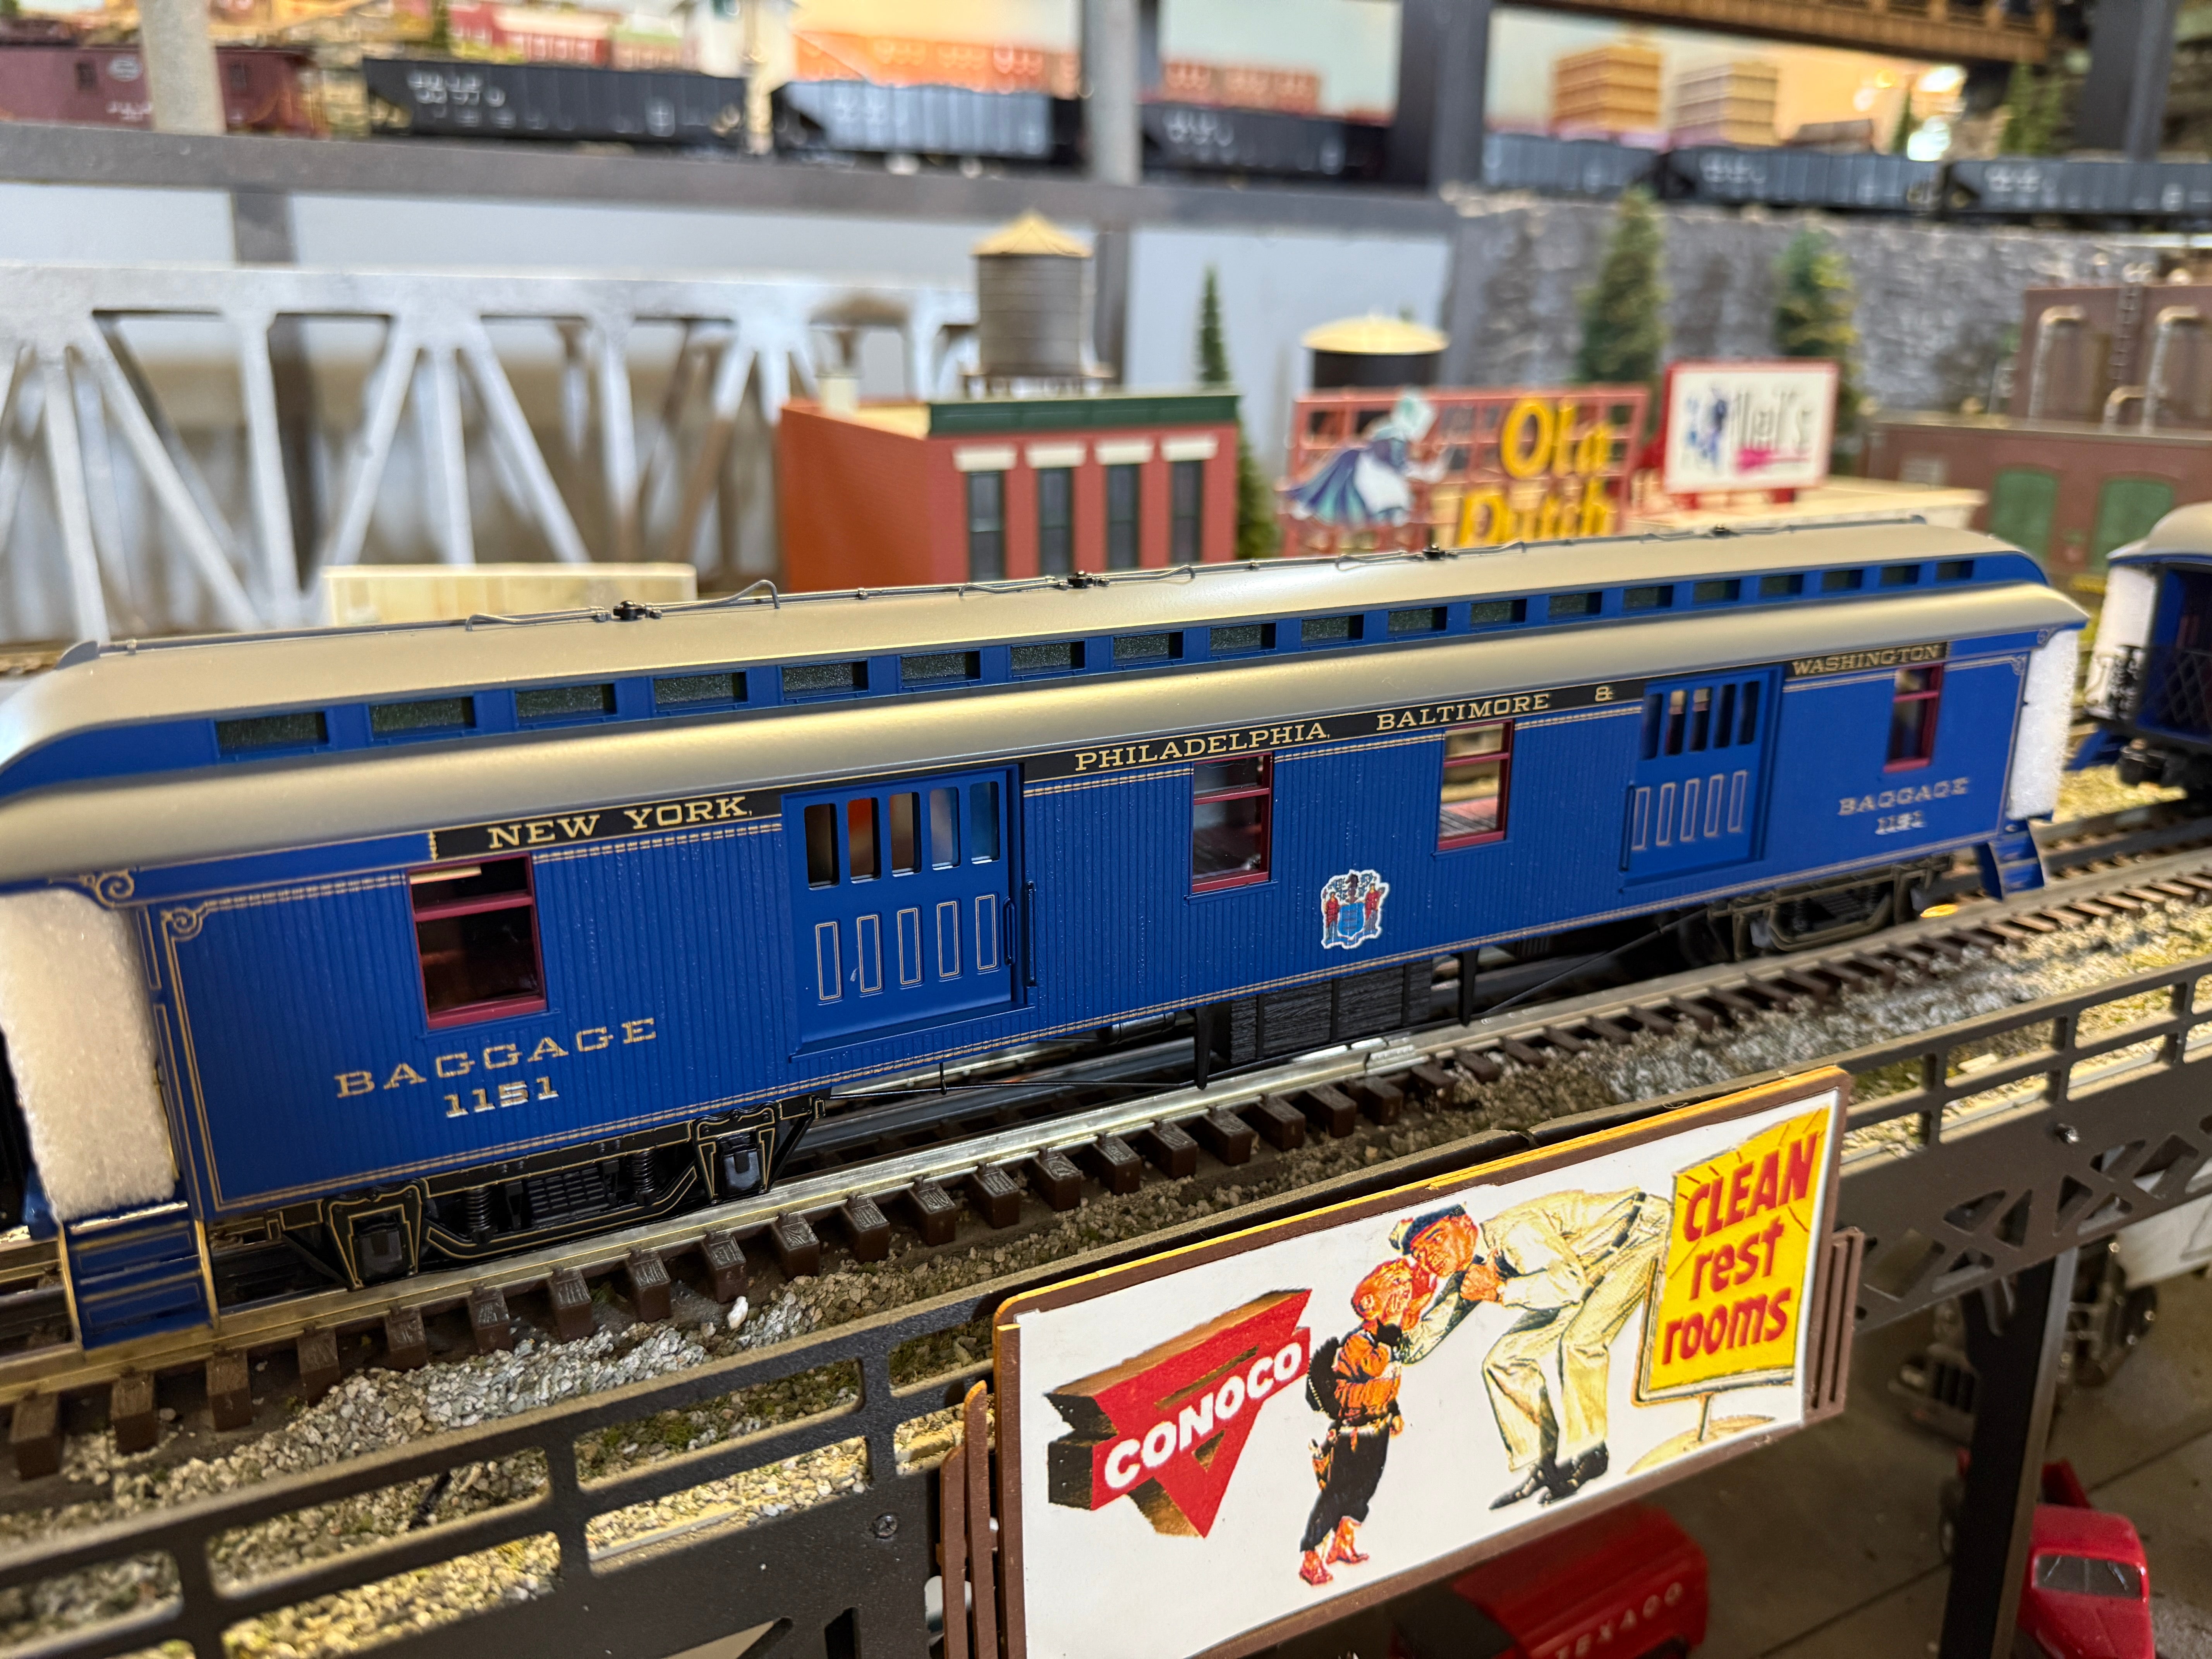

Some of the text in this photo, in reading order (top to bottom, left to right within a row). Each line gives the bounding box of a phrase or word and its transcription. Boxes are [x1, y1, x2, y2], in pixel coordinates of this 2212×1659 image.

[488, 644, 1942, 849] NEW YORK, PHILADELPHIA, BALTIMORE & WASHINGTON
[1838, 777, 1970, 816] BAGGAGE
[334, 1017, 657, 1098] BAGGAGE
[443, 1076, 559, 1118] 1151
[1683, 1131, 1819, 1242] CLEAN
[1689, 1215, 1785, 1300] rest
[1661, 1287, 1792, 1365] rooms
[1104, 1342, 1302, 1489] CONOCO
